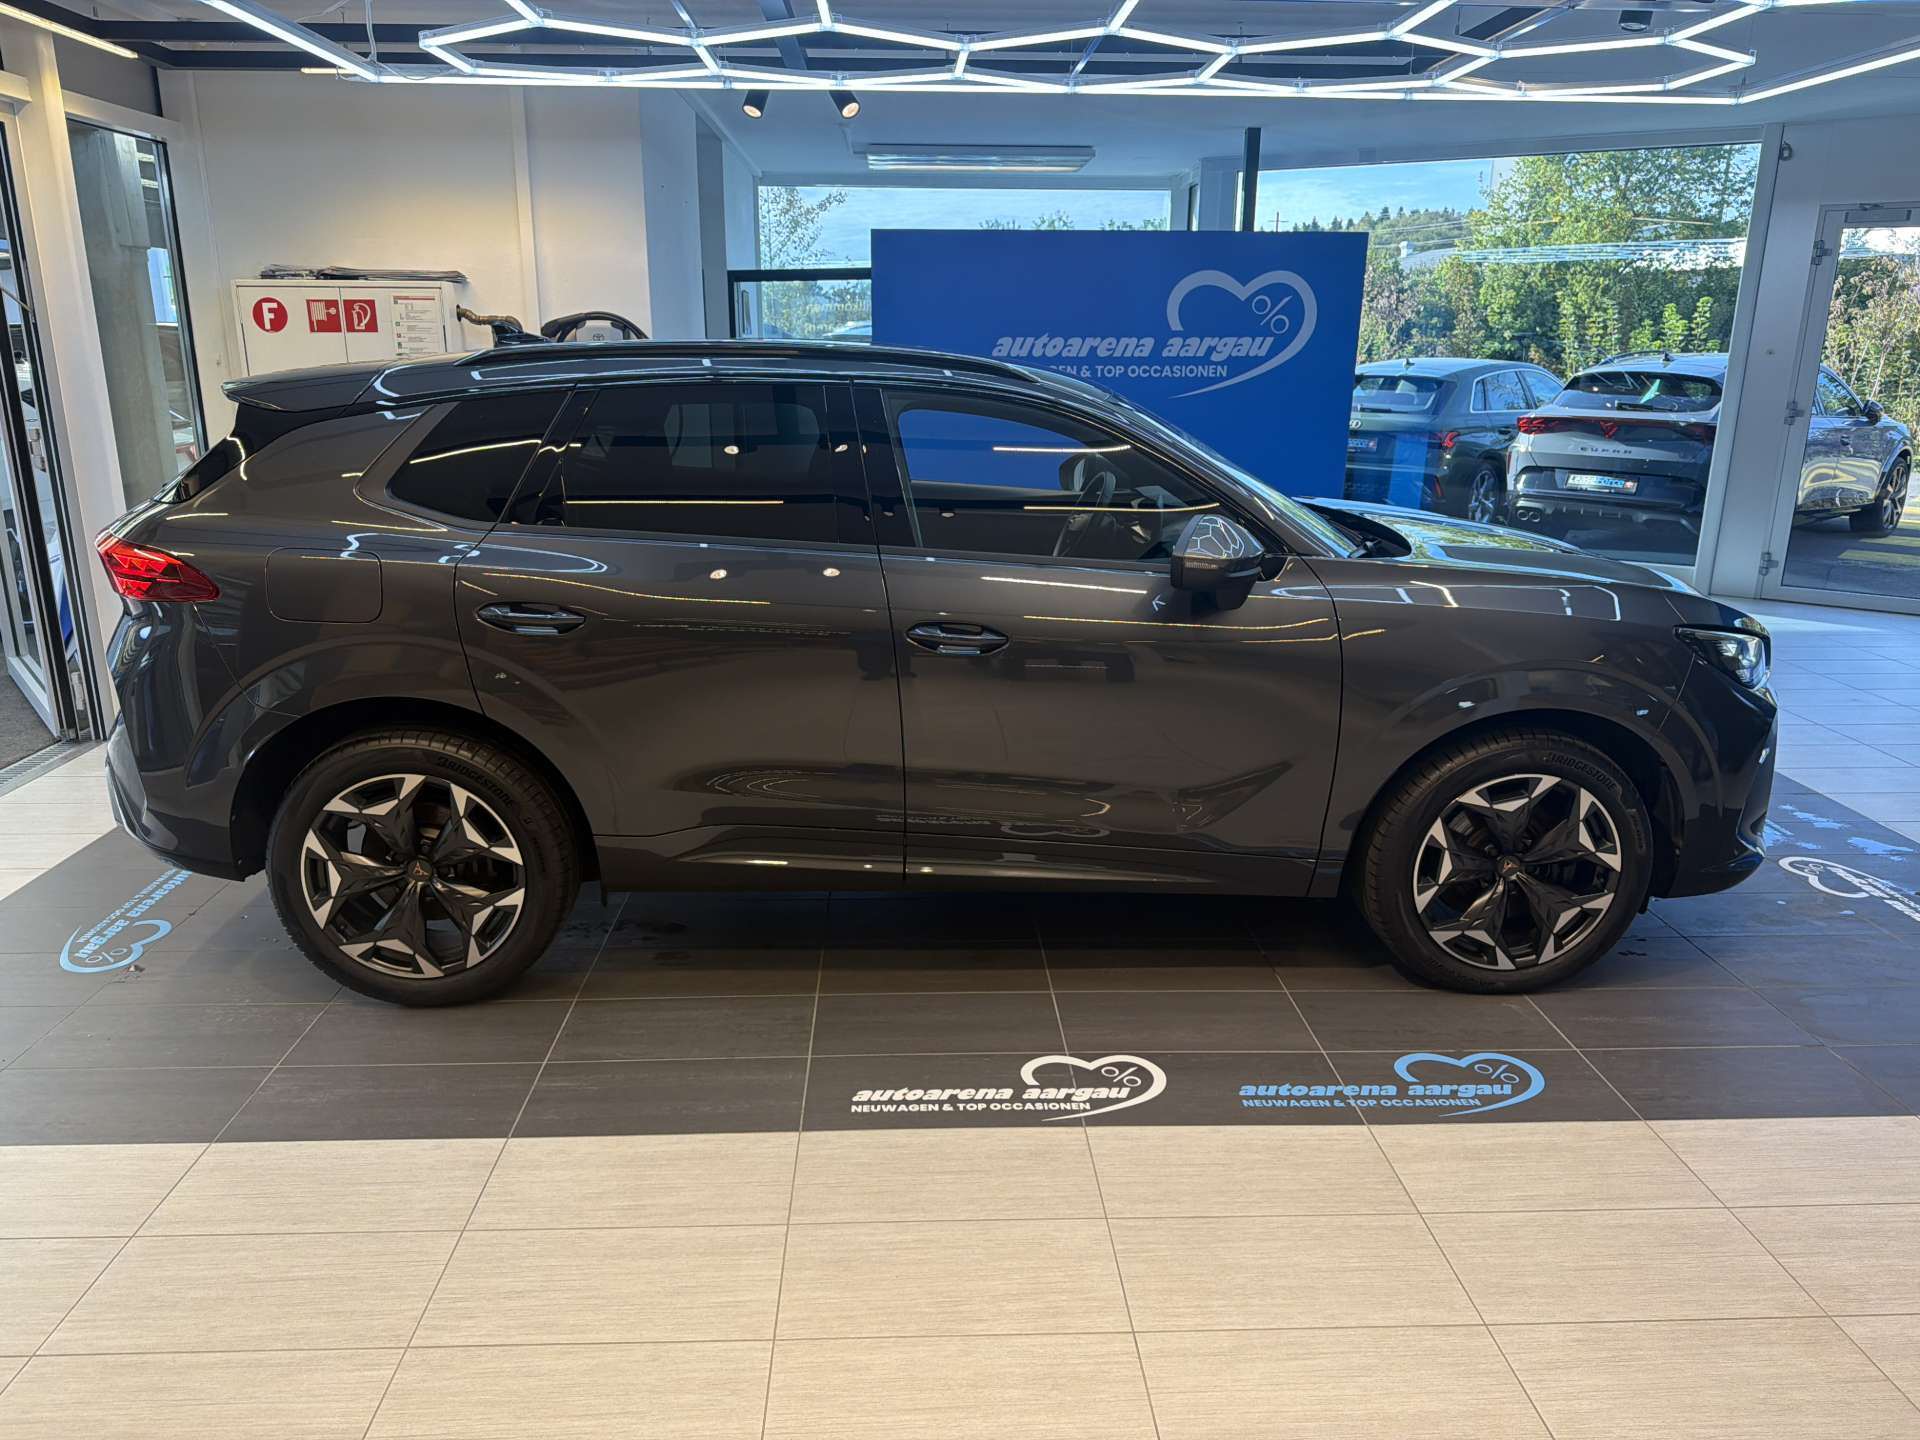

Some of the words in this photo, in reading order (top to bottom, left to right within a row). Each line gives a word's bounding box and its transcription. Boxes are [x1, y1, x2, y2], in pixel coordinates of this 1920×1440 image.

[261, 302, 278, 330] F
[992, 333, 1154, 358] autoarena
[1162, 336, 1274, 362] aargau
[1080, 366, 1091, 379] &
[1096, 365, 1125, 378] TOP
[1128, 365, 1228, 378] OCCASIONEN
[851, 1087, 1014, 1102] autoarena
[1022, 1086, 1131, 1102] aargau
[1239, 1083, 1397, 1097] autoarena
[1407, 1083, 1512, 1098] aargau
[850, 1103, 939, 1113] NEUWAGEN
[942, 1103, 954, 1112] &
[958, 1102, 987, 1112] TOP
[990, 1101, 1091, 1112] OCCASIONEN
[1242, 1099, 1332, 1108] NEUWAGEN
[1333, 1099, 1345, 1108] &
[1346, 1099, 1377, 1108] TOP
[1380, 1098, 1482, 1108] OCCASIONEN
